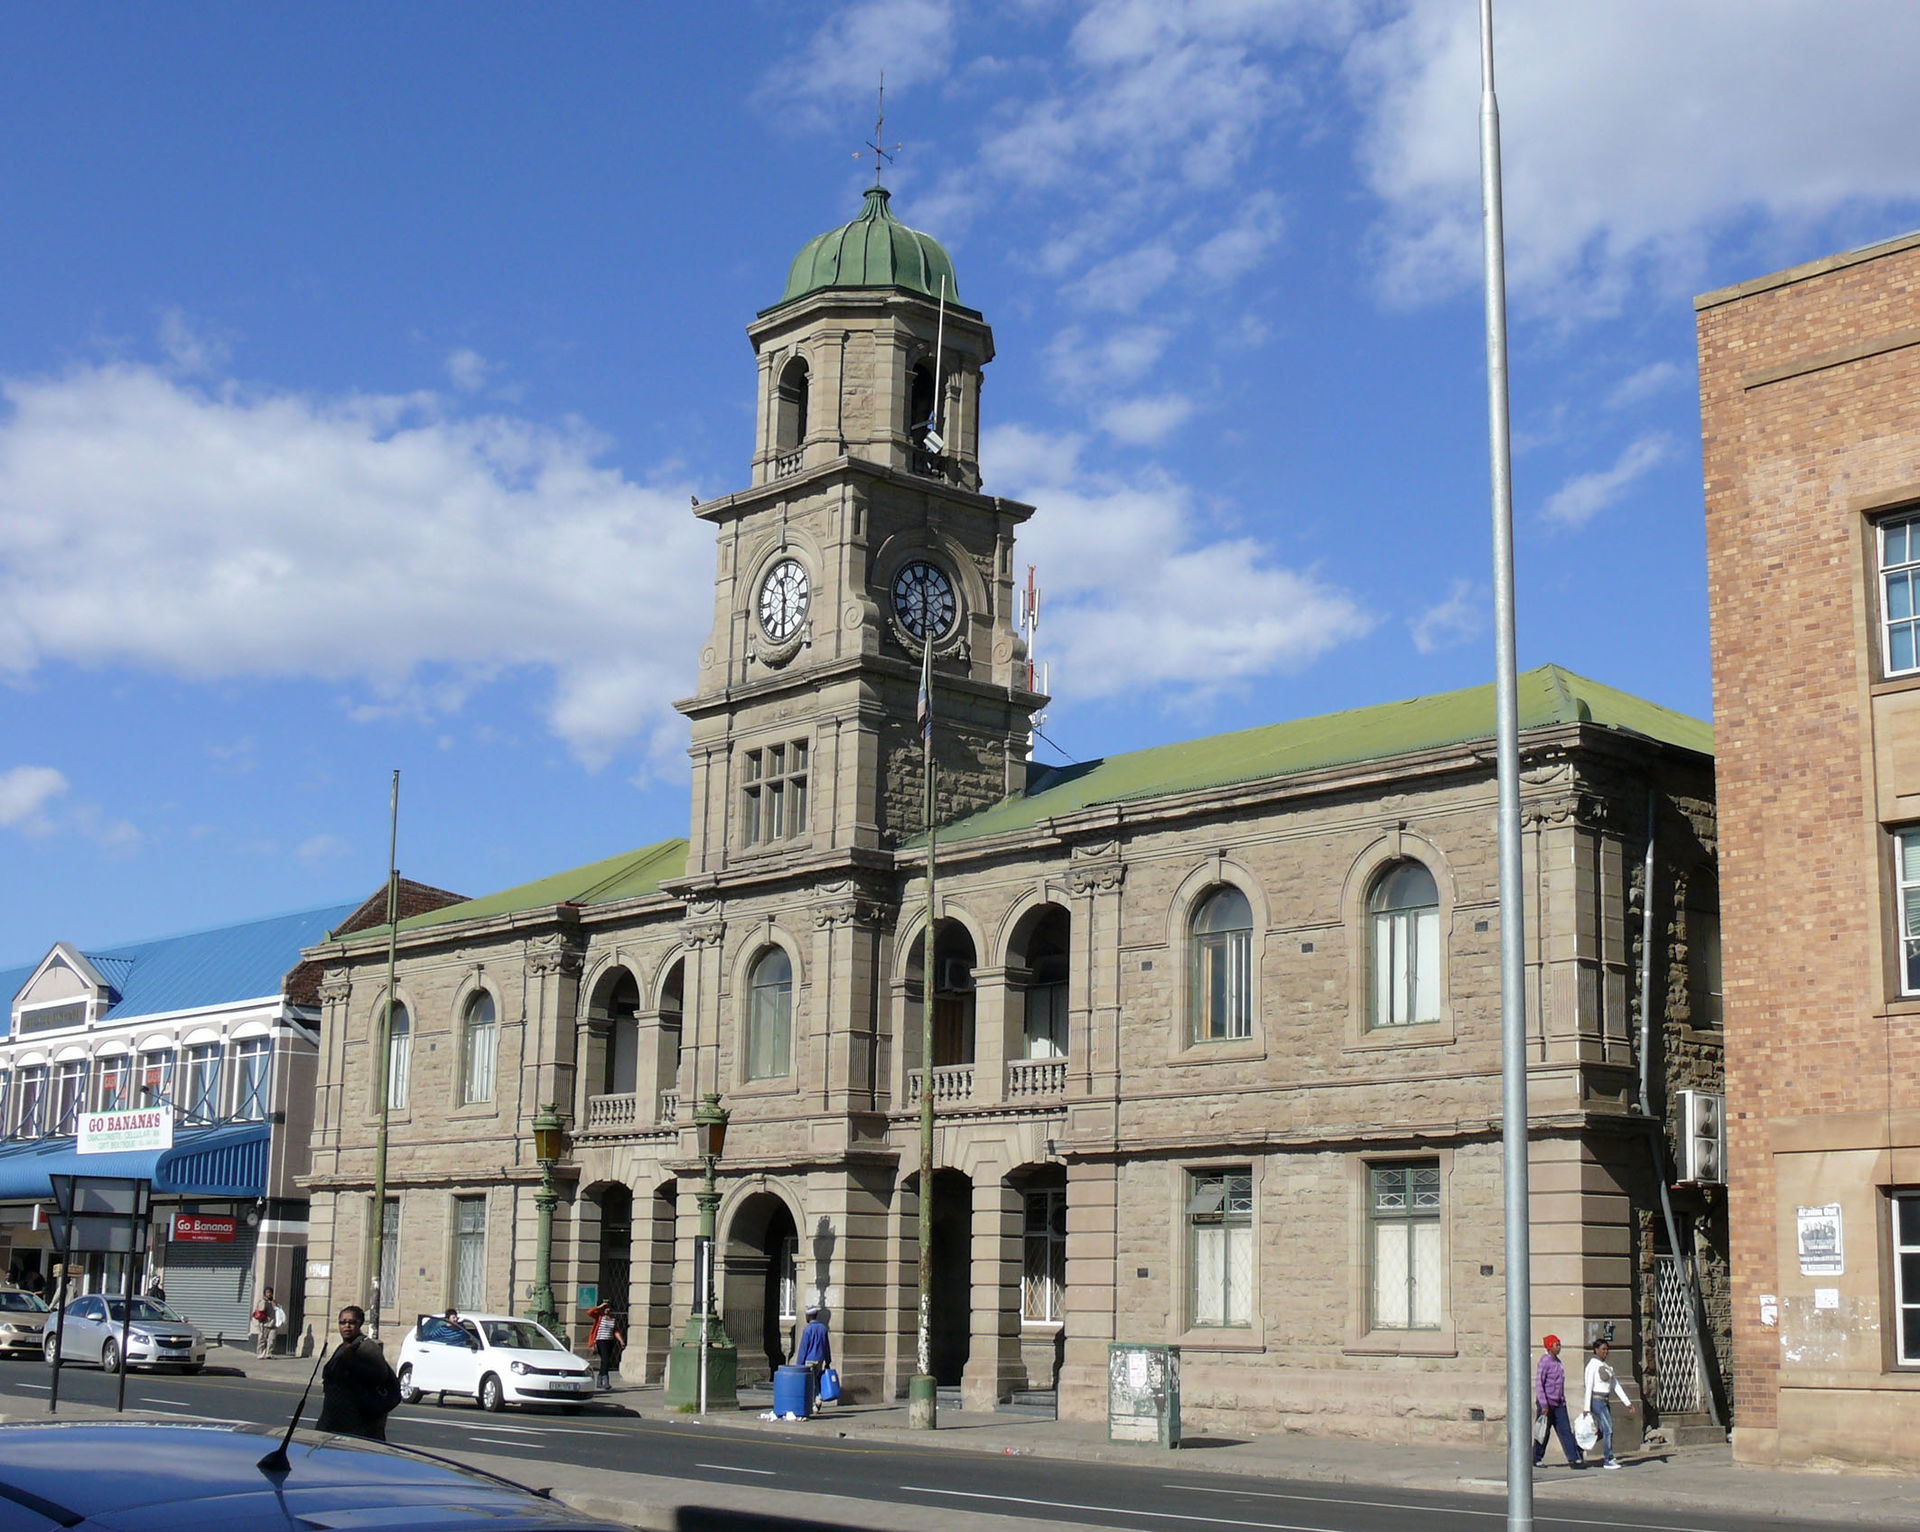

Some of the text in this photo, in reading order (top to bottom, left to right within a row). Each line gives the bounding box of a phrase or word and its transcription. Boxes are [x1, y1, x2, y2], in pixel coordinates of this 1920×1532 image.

[89, 1113, 161, 1132] GO BANANA'S
[177, 1219, 233, 1232] Go Bananas
